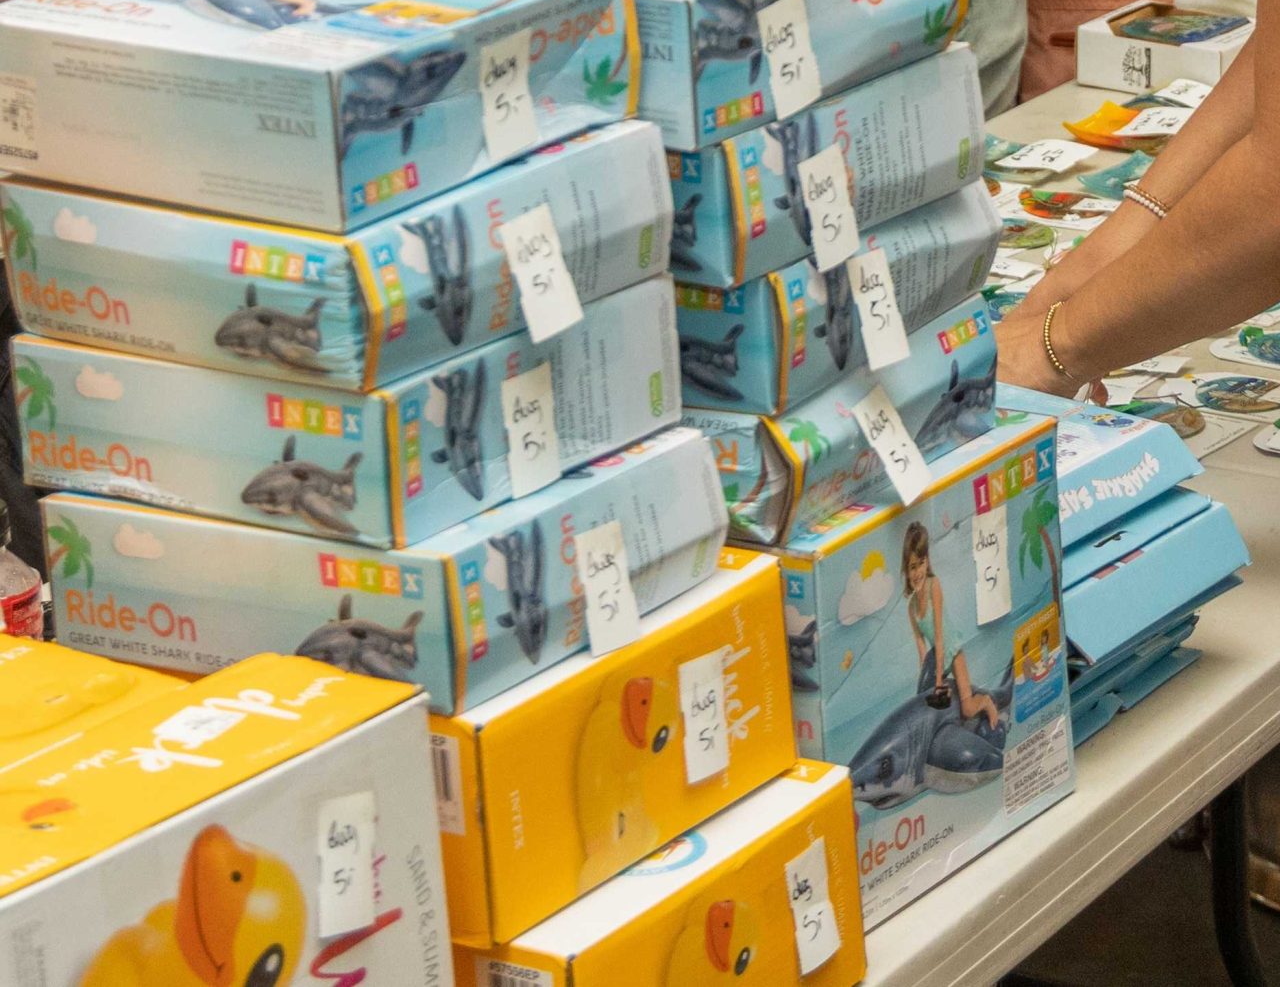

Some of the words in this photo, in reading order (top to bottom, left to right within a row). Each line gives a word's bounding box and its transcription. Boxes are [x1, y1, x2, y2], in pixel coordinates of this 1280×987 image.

[529, 2, 617, 62] Ride-O
[257, 113, 317, 138] INTEX
[703, 91, 763, 133] INTEX
[353, 162, 419, 212] INTEX
[230, 240, 326, 284] INTEX
[18, 271, 131, 326] Ride-On
[56, 322, 90, 338] WHITE
[937, 310, 988, 355] INTEX
[267, 393, 364, 441] INTEX
[28, 430, 153, 483] Ride-On
[973, 436, 1054, 516] INTEX
[1092, 451, 1160, 501] SHARKIE
[318, 552, 424, 599] INTEX
[65, 588, 197, 642] Ride-On
[461, 561, 490, 662] INTEX
[69, 630, 106, 648] GREAT
[108, 636, 148, 655] WHITE
[149, 643, 191, 663] SHARK
[860, 813, 926, 877] de-On
[867, 868, 895, 892] WHITE
[895, 849, 921, 871] SHARK
[921, 823, 955, 854] RIDE-ON
[406, 844, 435, 907] SAND
